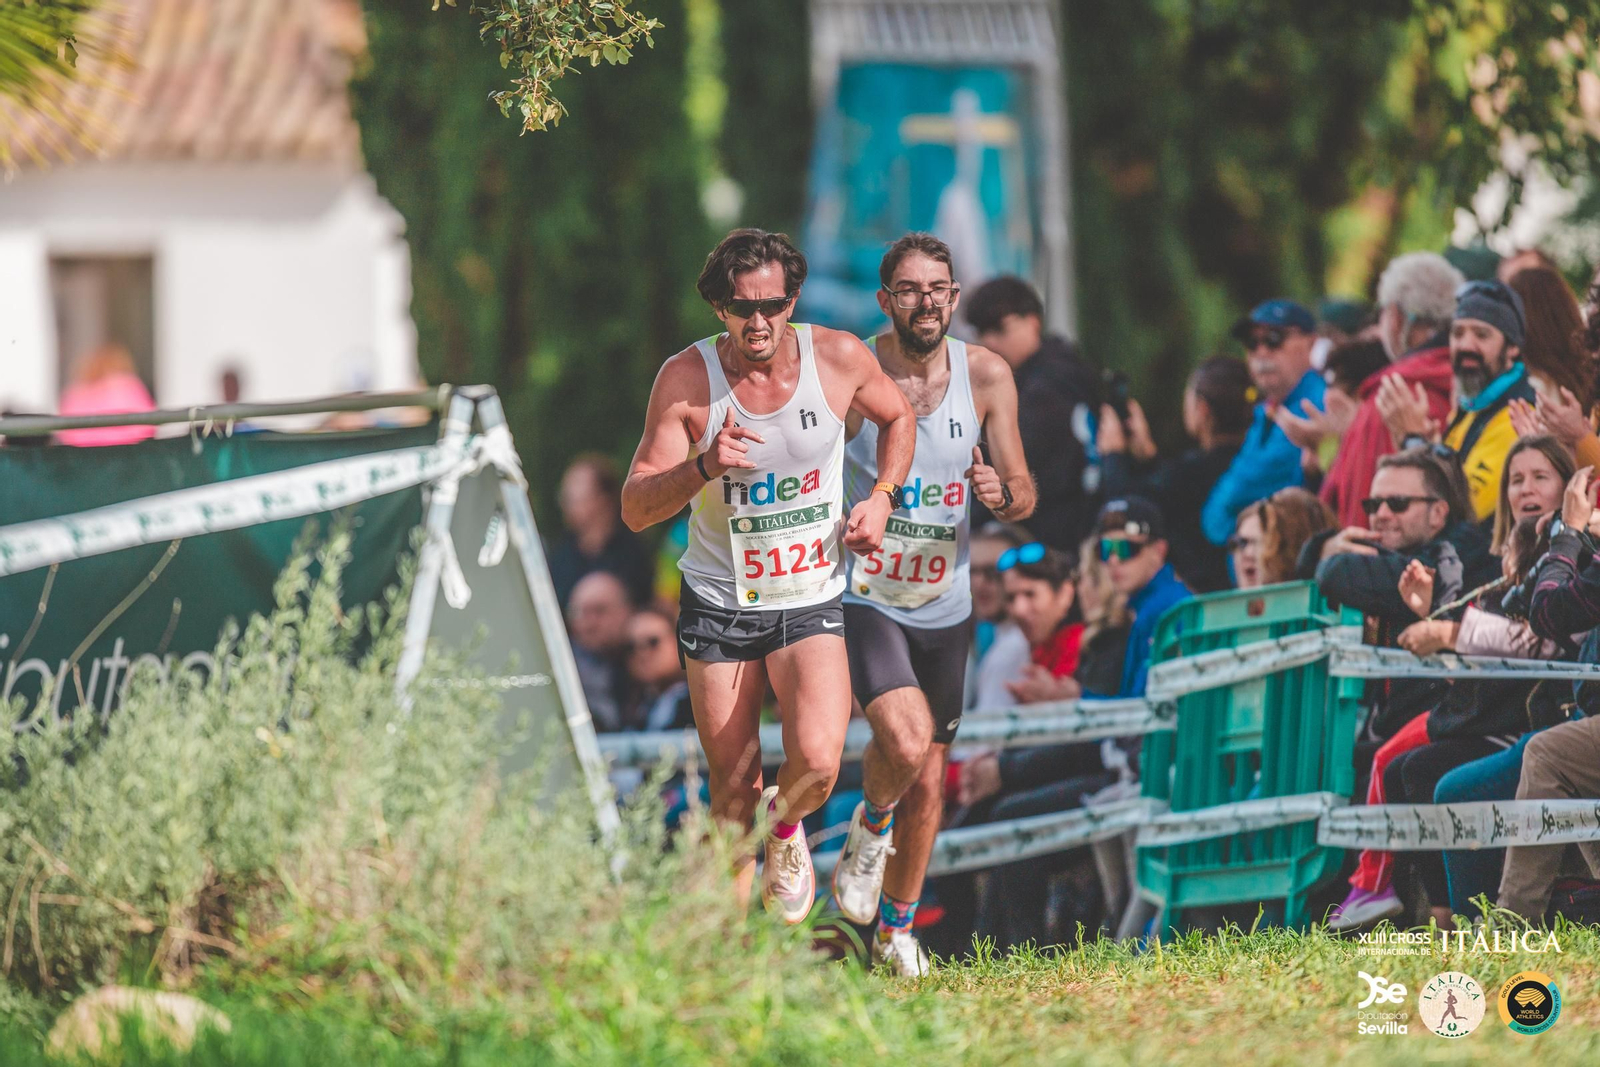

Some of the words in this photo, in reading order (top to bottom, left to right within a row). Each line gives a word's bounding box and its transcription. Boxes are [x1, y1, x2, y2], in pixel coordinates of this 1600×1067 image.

[722, 468, 821, 506] indea
[901, 477, 965, 510] dea
[759, 512, 807, 530] ITÁLICA
[891, 520, 937, 537] ITÁLICA
[743, 538, 831, 579] 5121
[864, 548, 947, 584] 5119
